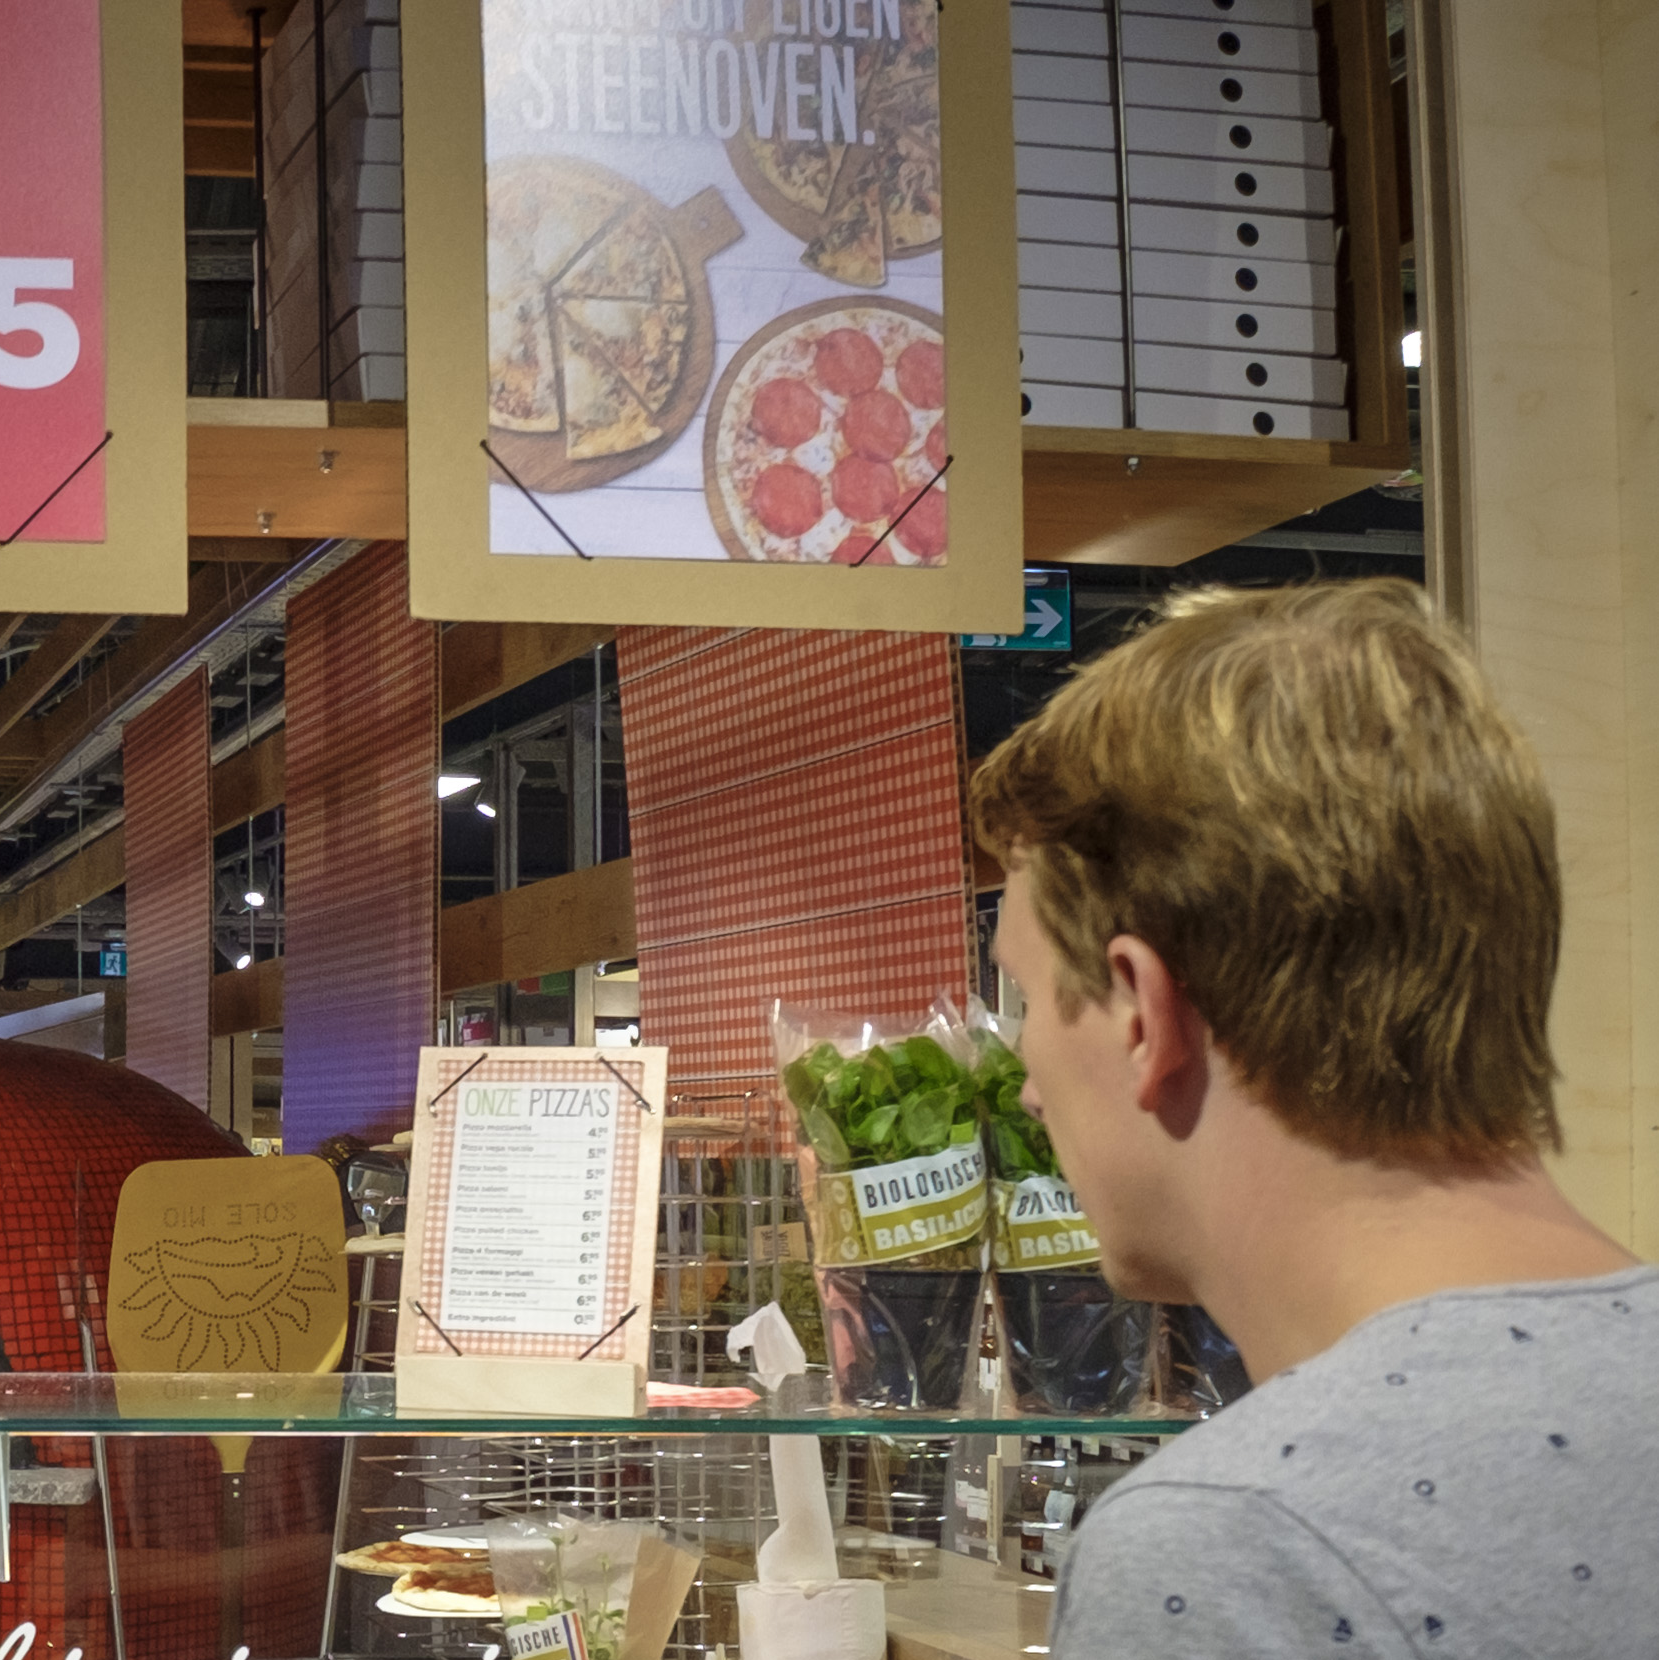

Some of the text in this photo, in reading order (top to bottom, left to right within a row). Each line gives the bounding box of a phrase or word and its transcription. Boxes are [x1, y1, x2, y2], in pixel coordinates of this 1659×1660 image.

[521, 32, 876, 146] STEENOVEN.
[465, 1088, 610, 1118] ONZE PIZZA'S
